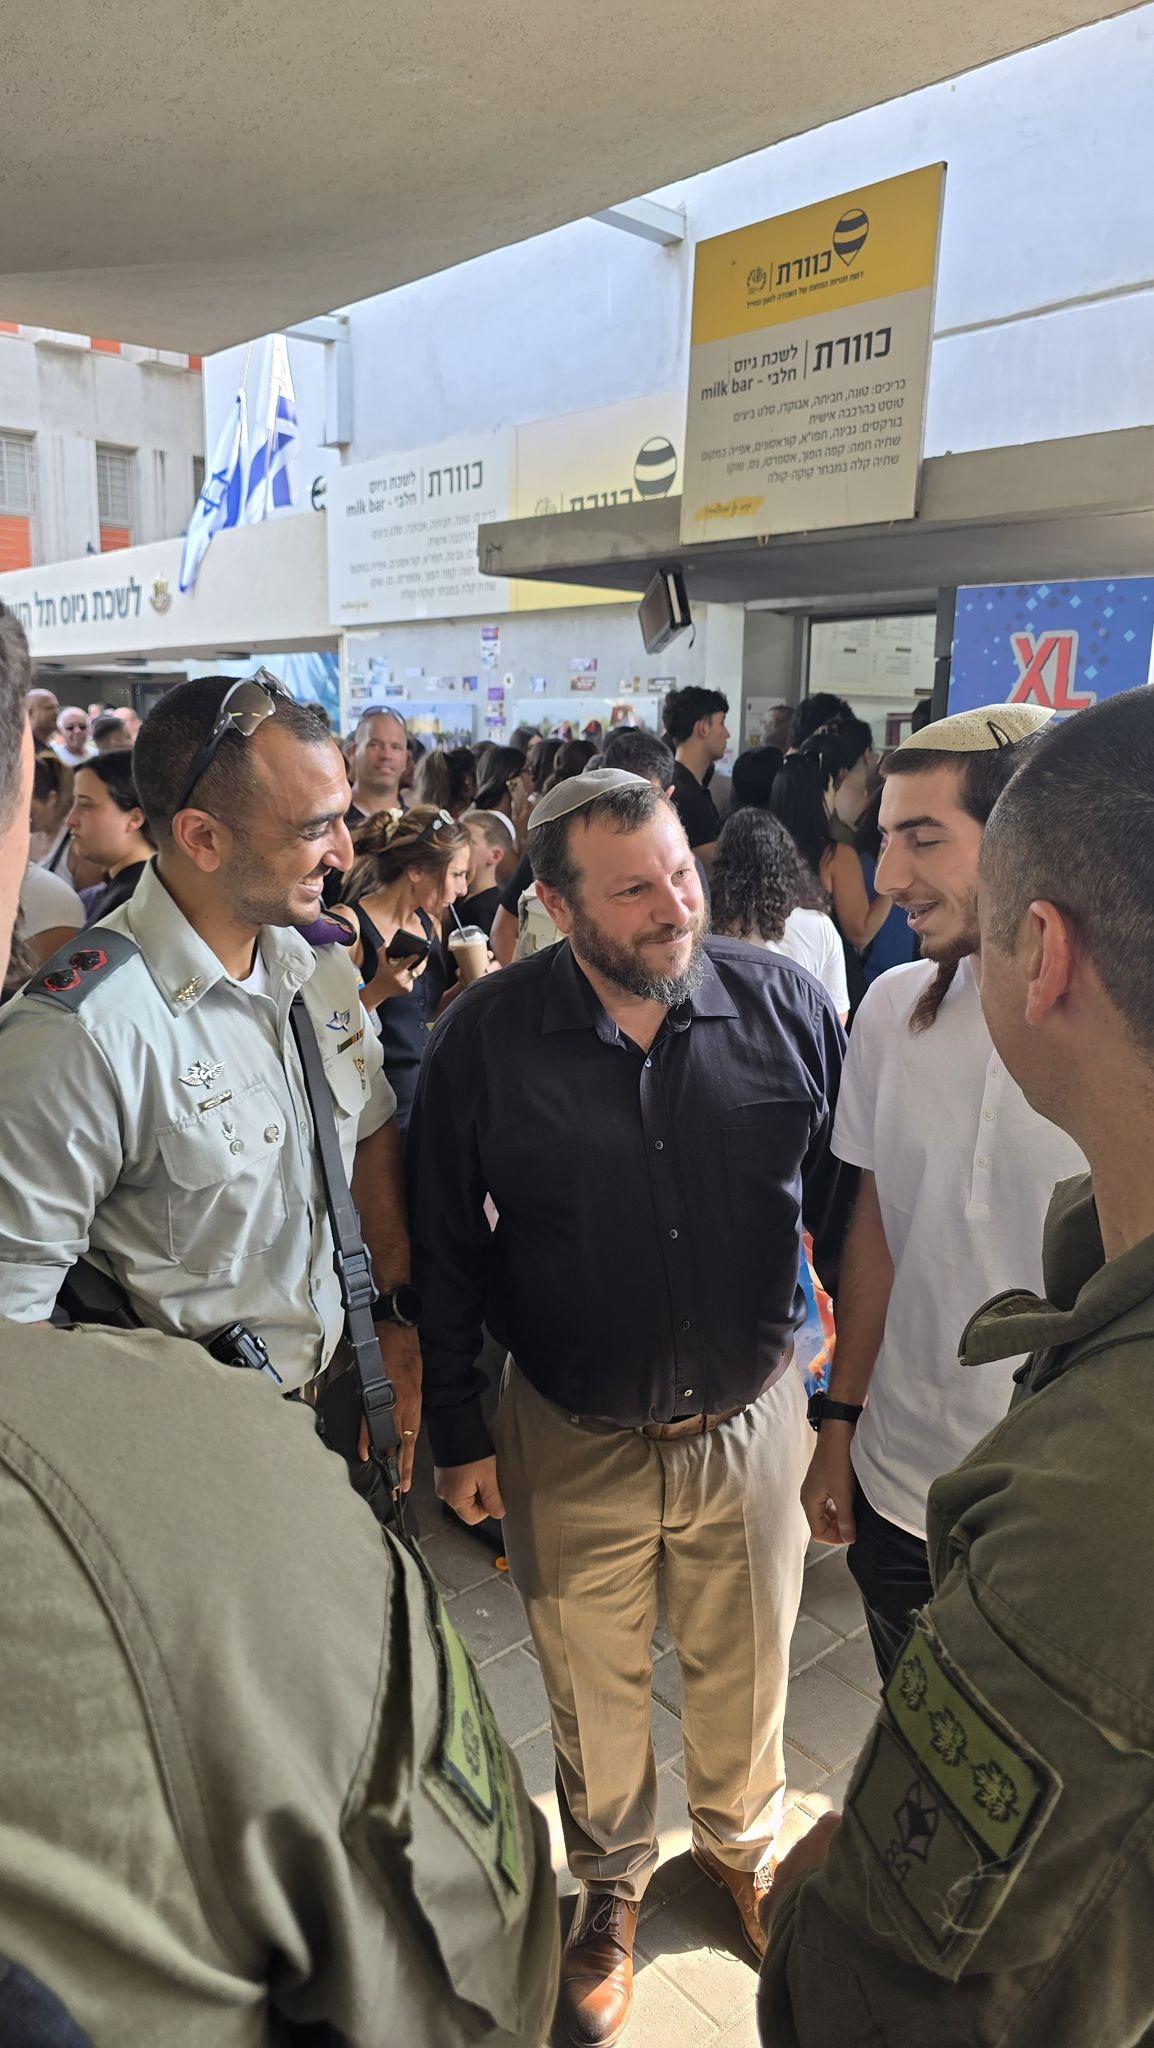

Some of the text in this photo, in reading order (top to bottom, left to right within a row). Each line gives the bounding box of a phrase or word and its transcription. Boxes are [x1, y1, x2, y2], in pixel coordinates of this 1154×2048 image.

[776, 250, 832, 286] כוורת
[734, 344, 798, 374] לשכת גיוס
[812, 327, 892, 372] כוורת
[767, 367, 797, 386] חלבי
[701, 380, 728, 401] milk
[731, 378, 754, 395] bar
[845, 386, 869, 401] טונה,
[872, 379, 906, 395] כריכים:
[811, 391, 843, 408] חביתה,
[733, 409, 755, 423] ביצים
[757, 404, 775, 418] סלט
[809, 397, 904, 426] טוסט בהרכבה אישית
[860, 416, 902, 433] בורקסים:
[825, 444, 845, 458] קפה
[874, 435, 901, 449] שתיה
[817, 462, 848, 476] במבחר
[850, 457, 871, 472] קלה
[873, 454, 900, 468] שתיה
[389, 471, 417, 490] לשכת
[428, 461, 483, 498] כוורת
[346, 499, 367, 517] milk
[368, 498, 385, 513] bar
[93, 576, 142, 621] לשכת
[35, 591, 57, 628] תל
[60, 594, 88, 625] גיוס
[1008, 632, 1094, 713] XL
